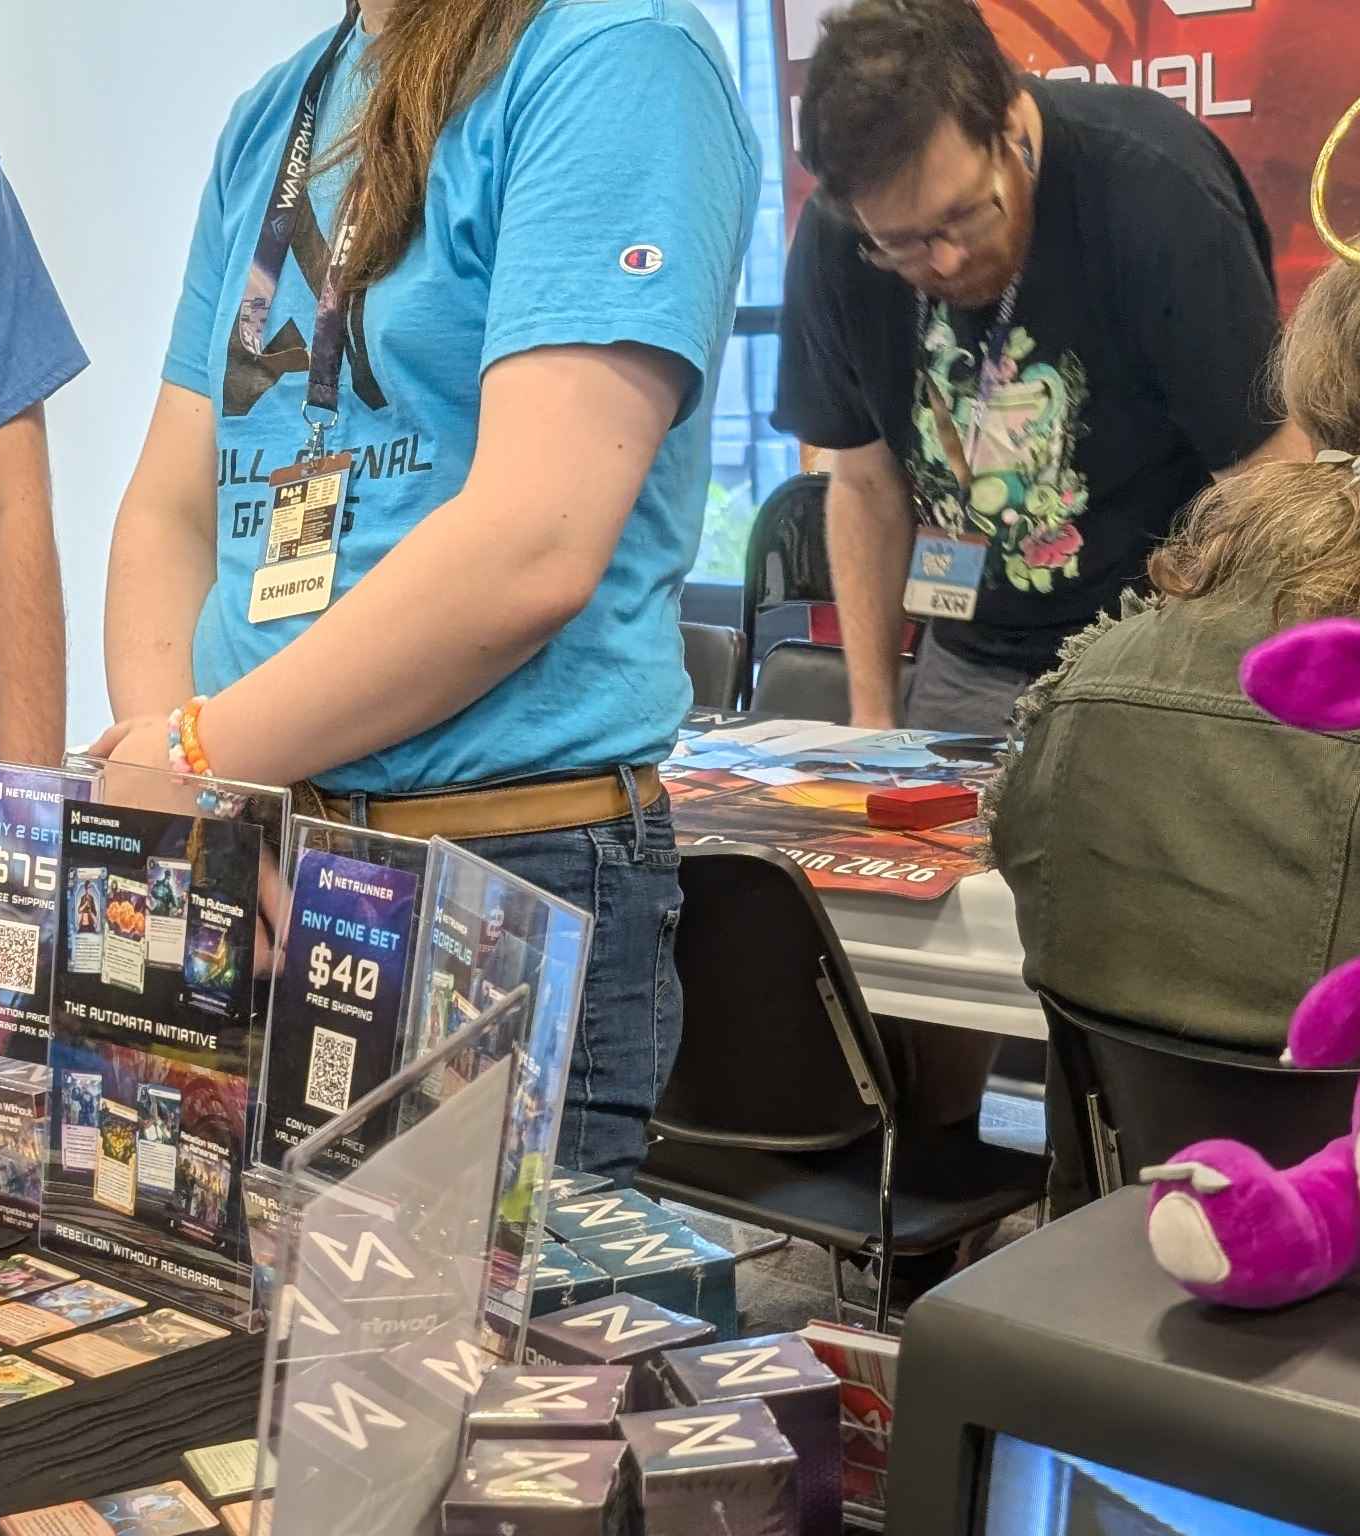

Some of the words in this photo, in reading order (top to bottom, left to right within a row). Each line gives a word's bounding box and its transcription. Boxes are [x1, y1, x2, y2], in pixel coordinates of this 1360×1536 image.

[260, 575, 325, 602] EXHIBITOR
[6, 788, 64, 804] NETRUNNE
[16, 825, 25, 838] 2
[70, 828, 141, 853] LIBERATION
[833, 855, 943, 883] 2026
[191, 893, 206, 907] The
[334, 875, 394, 901] NETRUNNER
[11, 894, 55, 911] SHIPPING
[301, 909, 332, 934] ANY
[335, 918, 365, 942] ONE
[369, 928, 401, 951] SET
[433, 927, 473, 966] BOREALIS
[308, 941, 380, 1001] $40
[305, 991, 329, 1009] FREE
[331, 999, 373, 1023] SHIPPING
[64, 1001, 87, 1016] THE
[89, 1006, 152, 1035] AUTOMATA
[155, 1022, 217, 1049] INITIATIVE
[274, 1128, 299, 1146] VALID
[55, 1224, 111, 1251] REBELLION
[113, 1242, 157, 1267] WITHOUT
[160, 1258, 224, 1291] REHEARSAL
